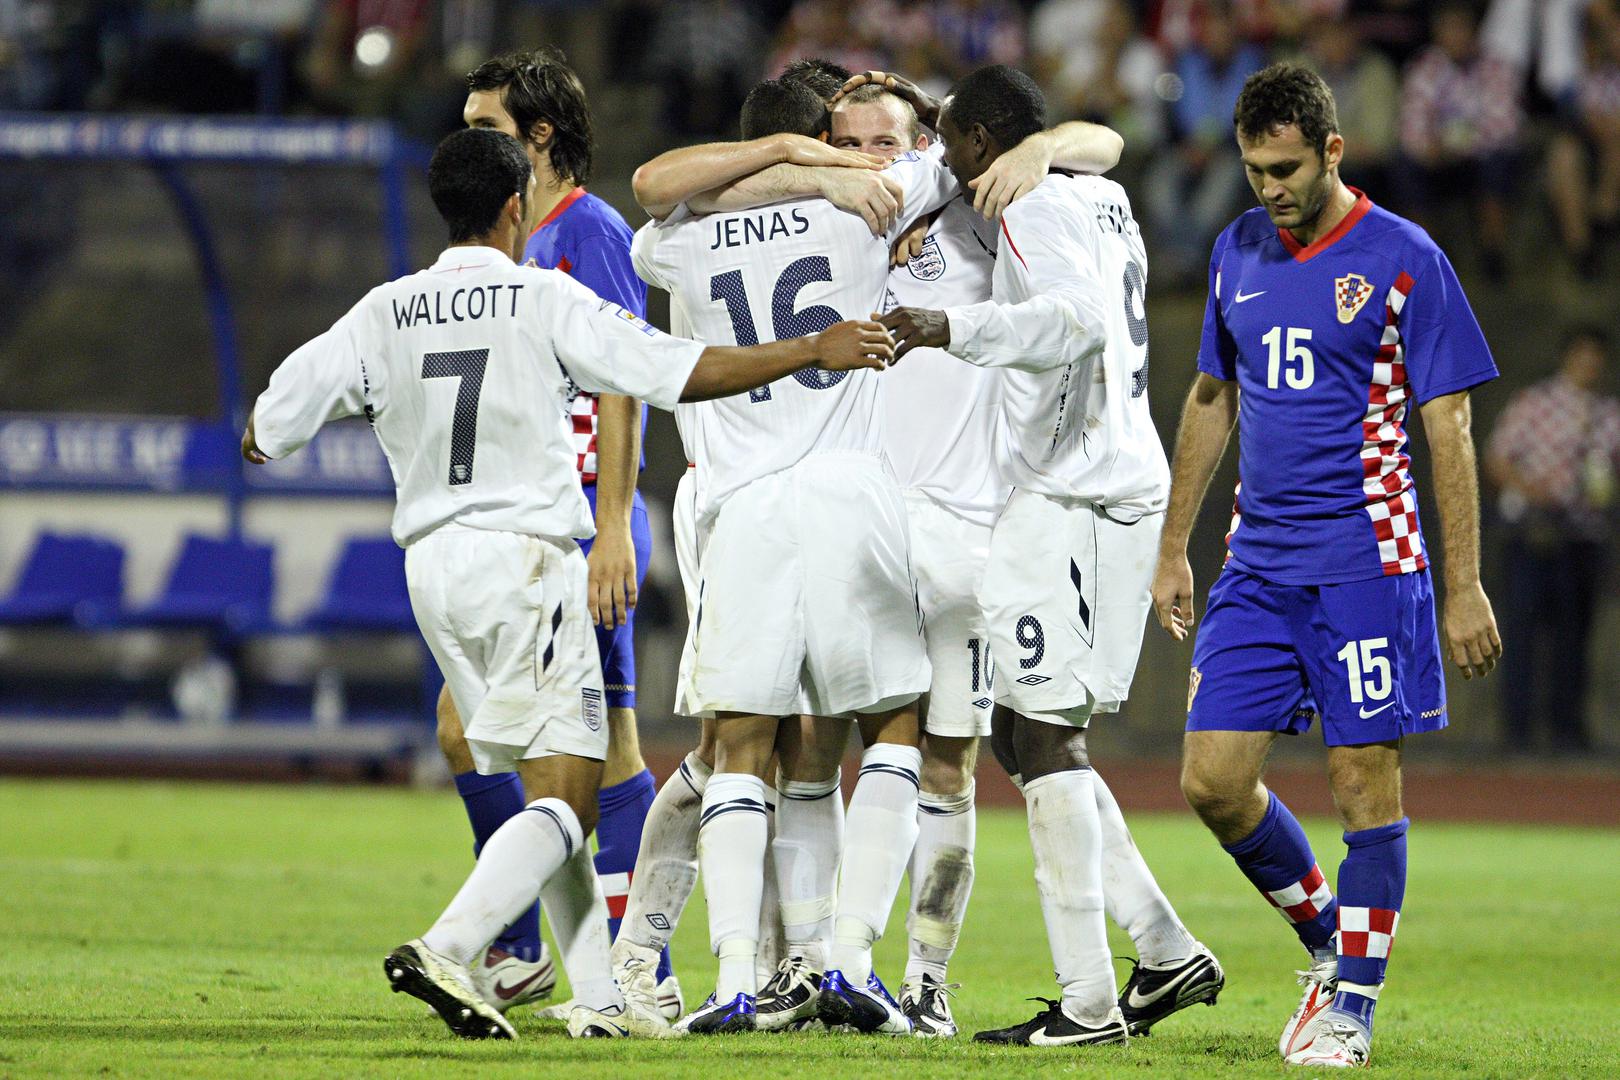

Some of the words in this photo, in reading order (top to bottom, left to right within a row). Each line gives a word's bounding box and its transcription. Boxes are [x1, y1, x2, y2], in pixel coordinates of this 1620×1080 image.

[711, 208, 810, 250] JENAS
[392, 285, 524, 330] WALCOTT
[710, 255, 848, 404] 16
[1122, 260, 1150, 398] 9
[1261, 326, 1315, 390] 15
[420, 348, 490, 486] 7
[1015, 614, 1045, 669] 9
[1337, 637, 1393, 703] 15
